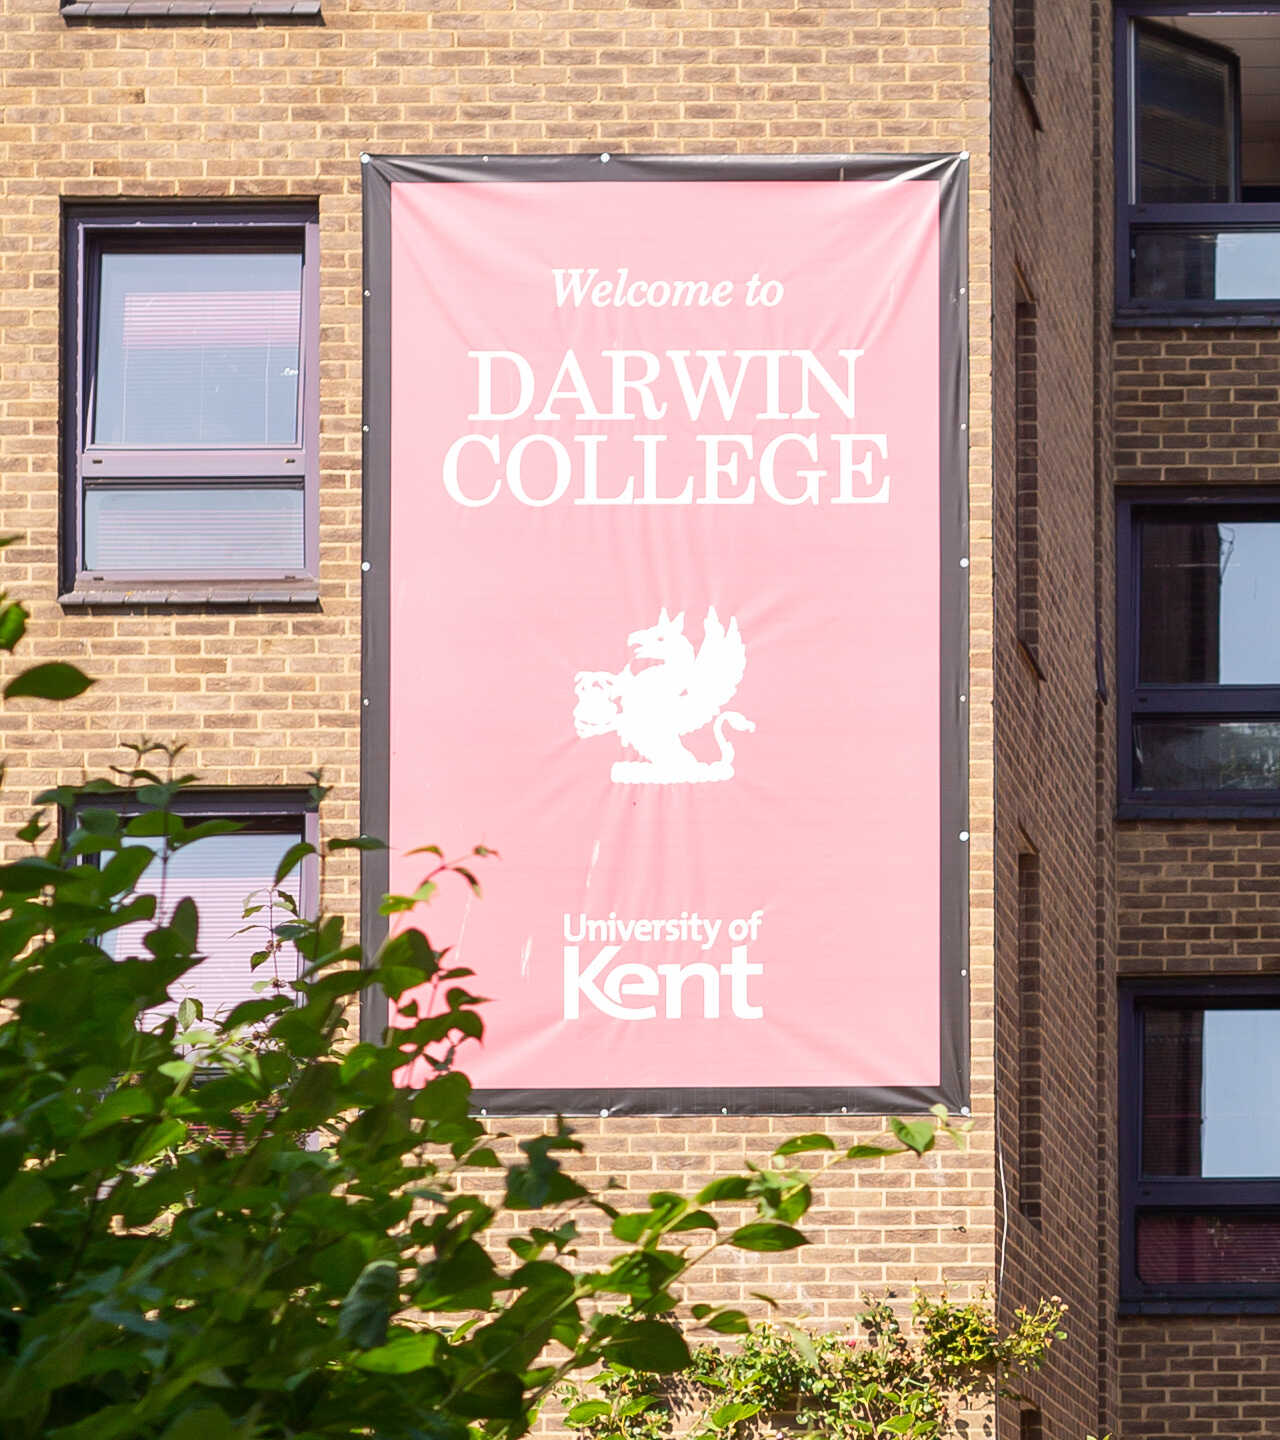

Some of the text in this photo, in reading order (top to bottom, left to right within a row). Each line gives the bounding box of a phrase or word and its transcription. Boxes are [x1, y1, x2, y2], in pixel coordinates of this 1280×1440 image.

[551, 267, 784, 308] Welcome to
[467, 348, 864, 421] DARWIN
[442, 432, 891, 508] COLLEGE
[563, 909, 764, 950] University of
[563, 944, 764, 1020] Kent
